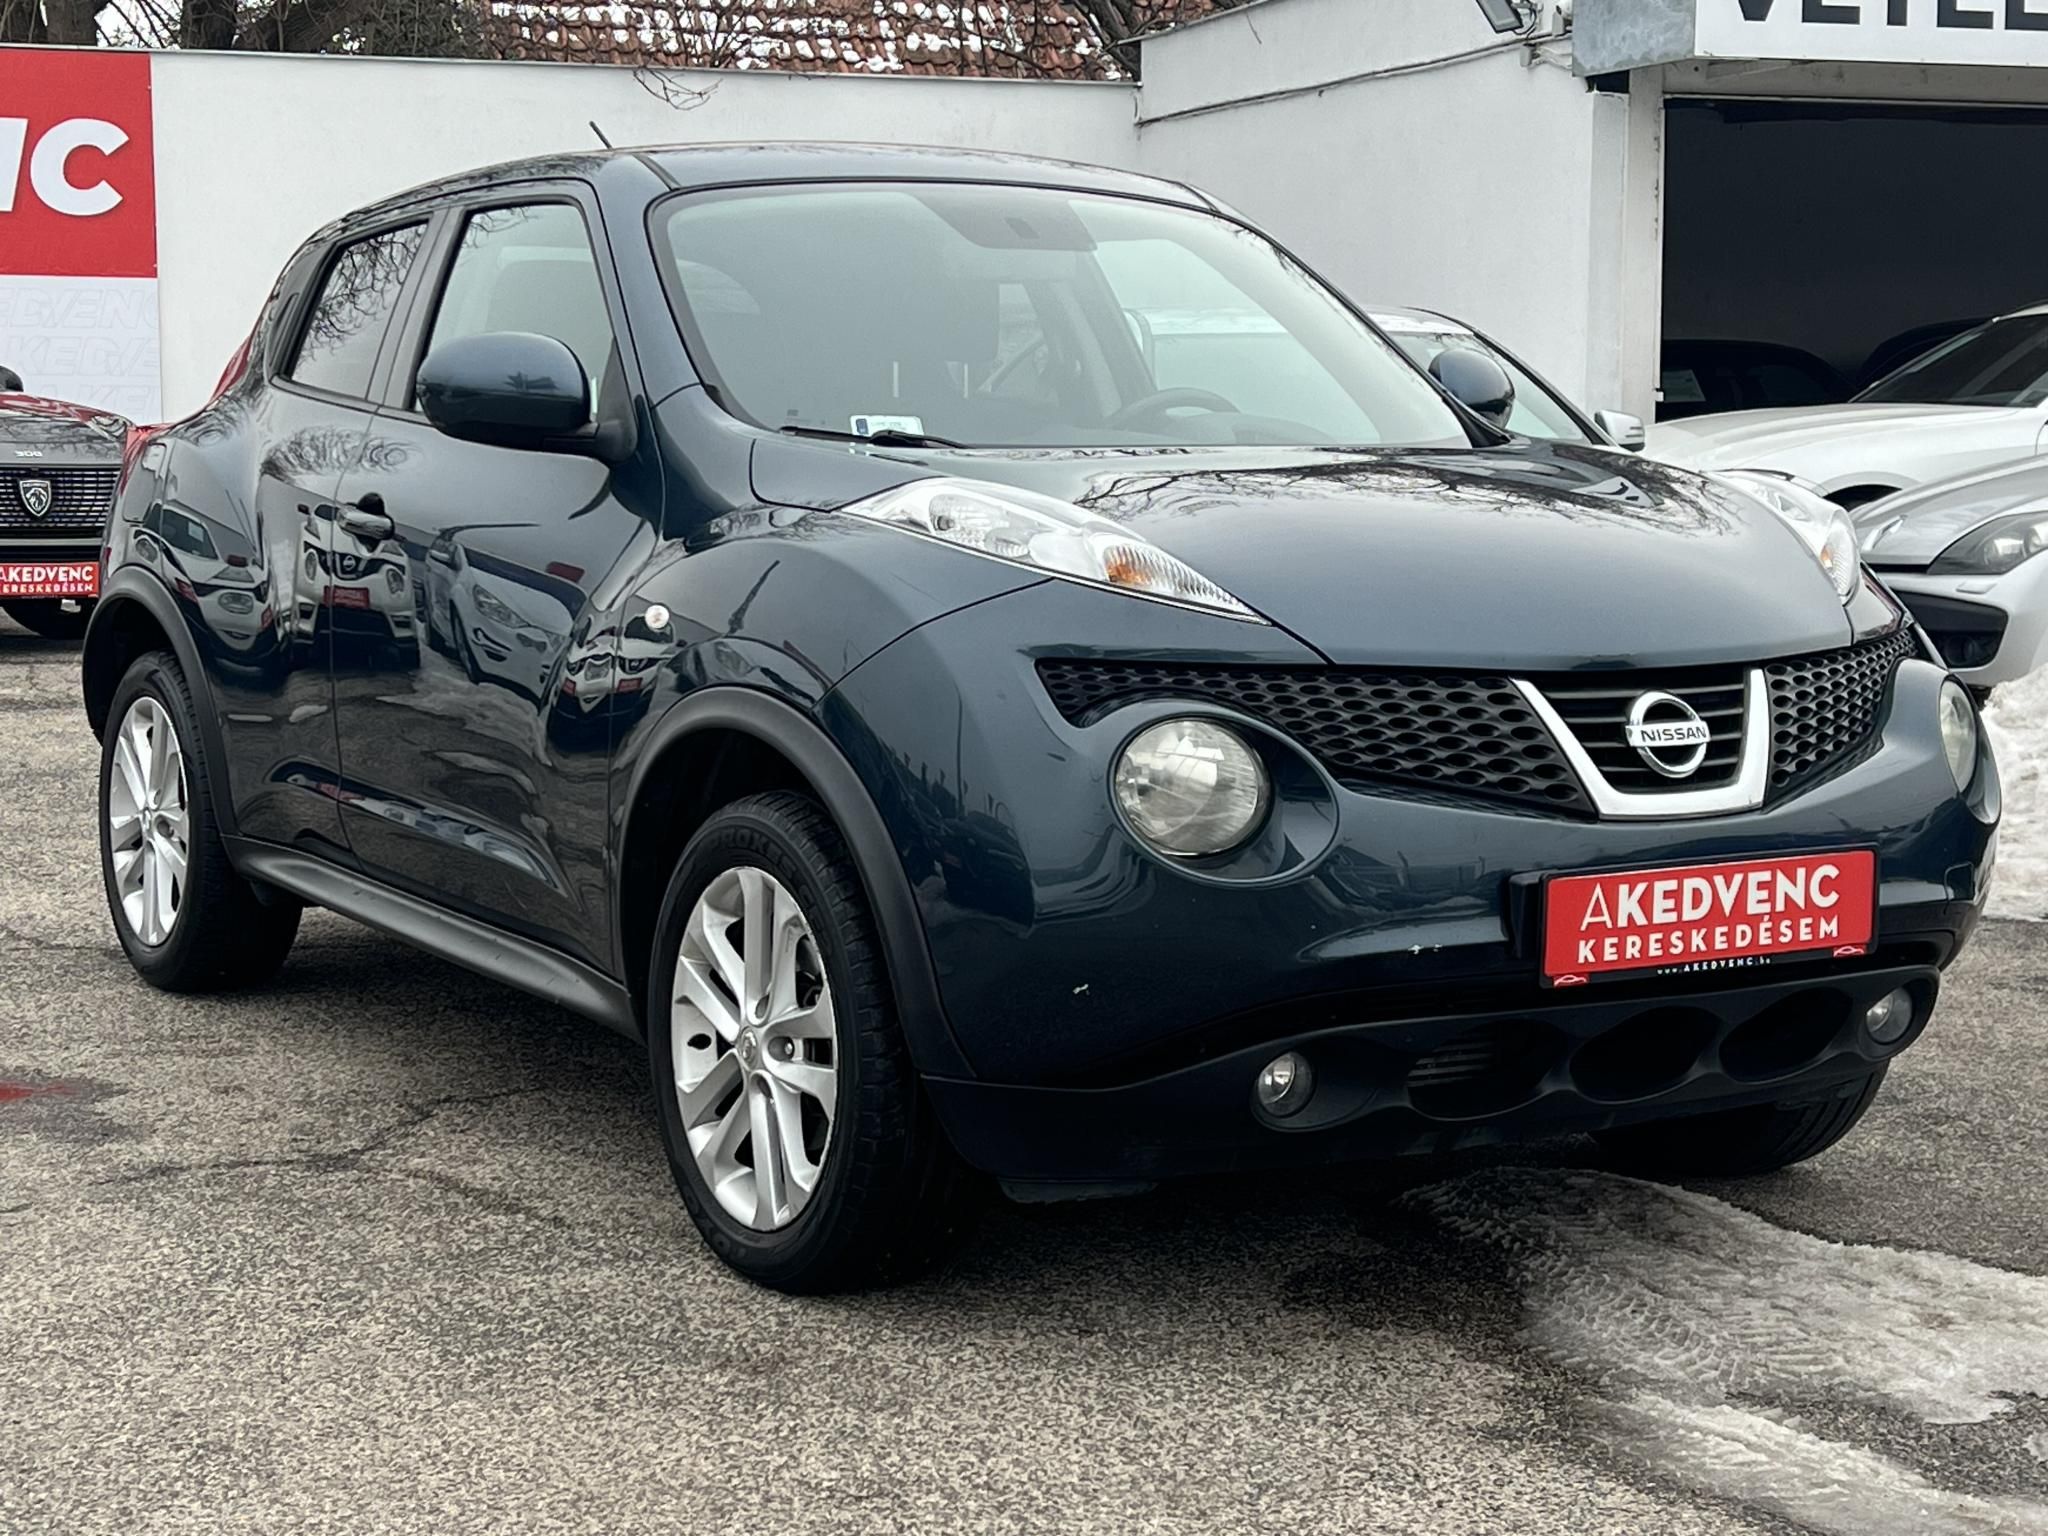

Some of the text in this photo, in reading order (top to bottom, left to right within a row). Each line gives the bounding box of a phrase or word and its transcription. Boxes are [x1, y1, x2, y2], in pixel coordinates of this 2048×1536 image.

[0, 582, 93, 593] ERESKEDÉSEM
[1641, 726, 1707, 742] NISSAN
[1579, 864, 1840, 932] AKEDVENC
[1577, 914, 1839, 964] KERESKEDÉSEM
